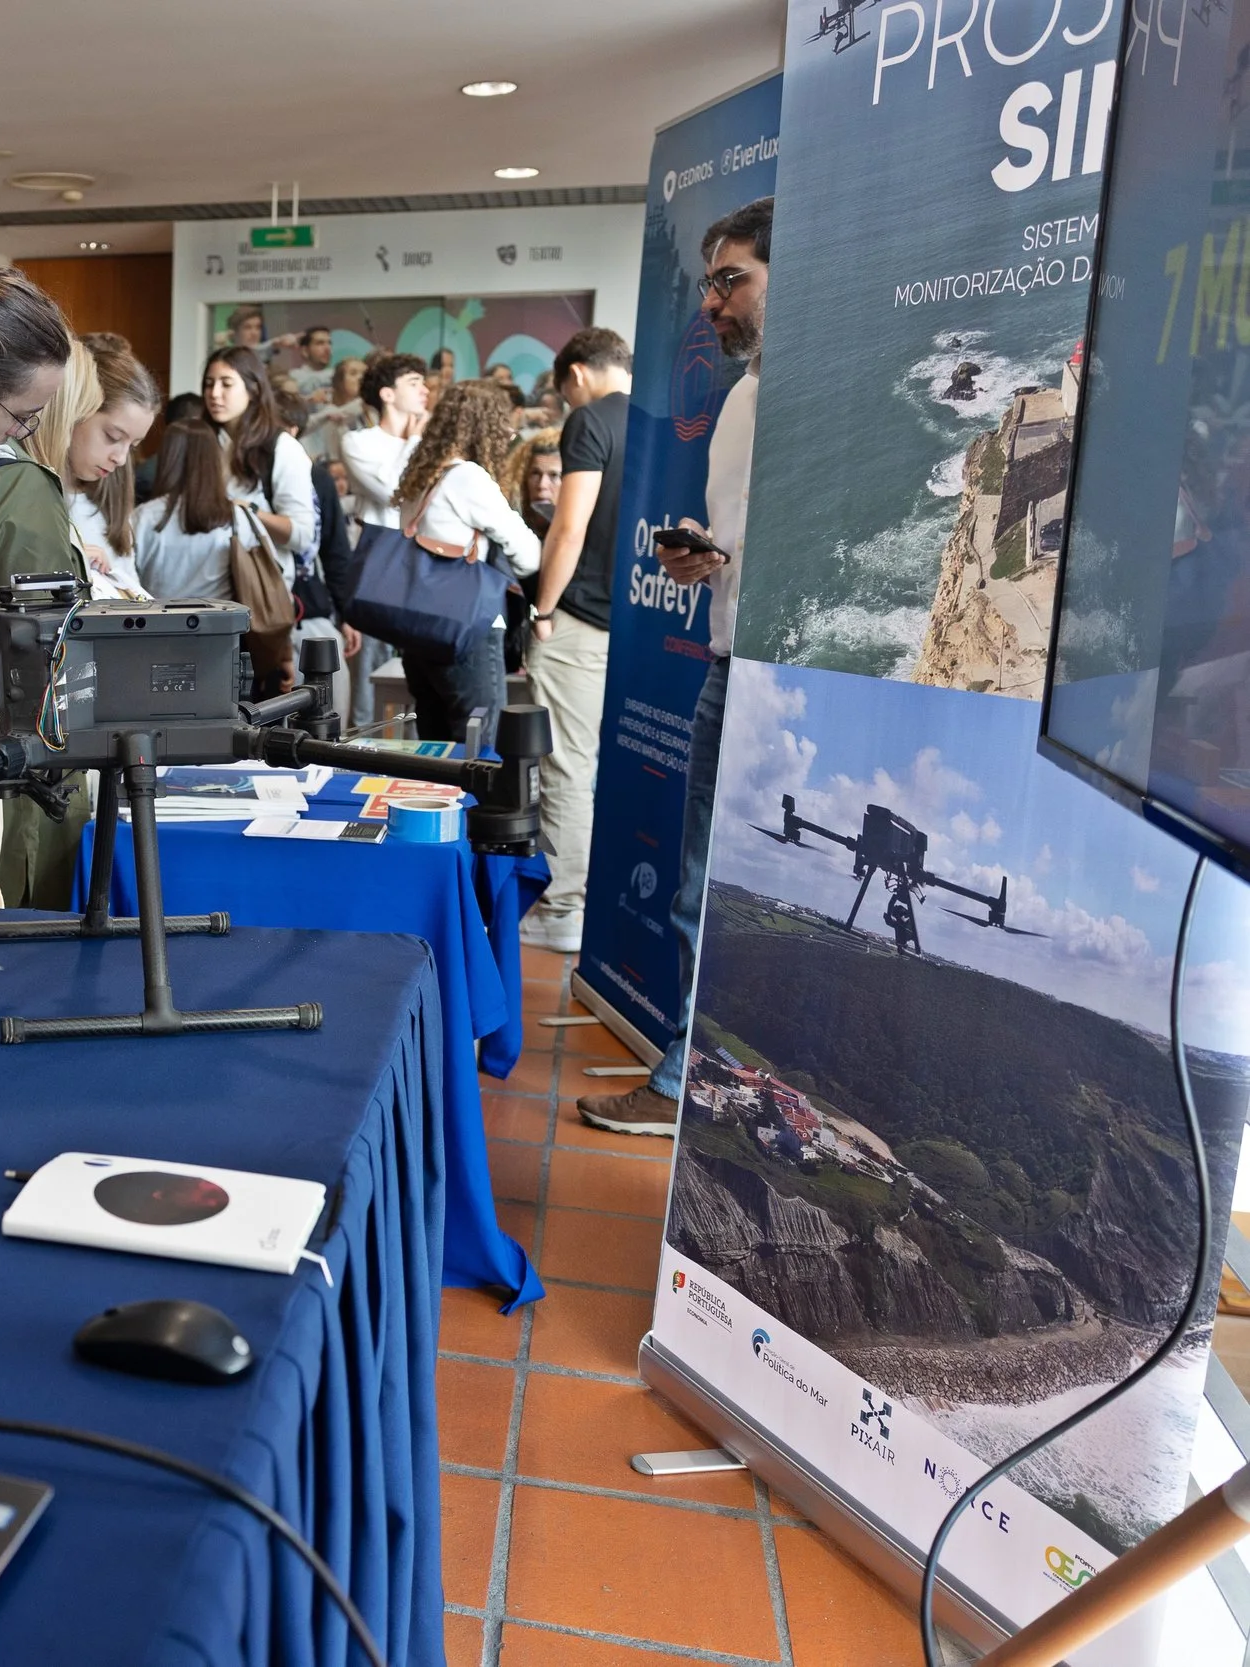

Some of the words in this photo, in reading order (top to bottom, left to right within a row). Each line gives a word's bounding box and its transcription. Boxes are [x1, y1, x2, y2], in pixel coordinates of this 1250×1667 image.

[678, 160, 714, 190] CEDROS
[1022, 213, 1099, 251] SISTEM
[894, 256, 1065, 308] MONITORIZAÇÃO
[629, 563, 703, 630] Safety
[688, 1290, 733, 1328] PORTUGUESA
[689, 1280, 726, 1311] REPÚBLICA
[763, 1352, 794, 1384] Política
[796, 1378, 808, 1393] do
[810, 1386, 829, 1407] Mar
[851, 1422, 896, 1466] PIXAIR
